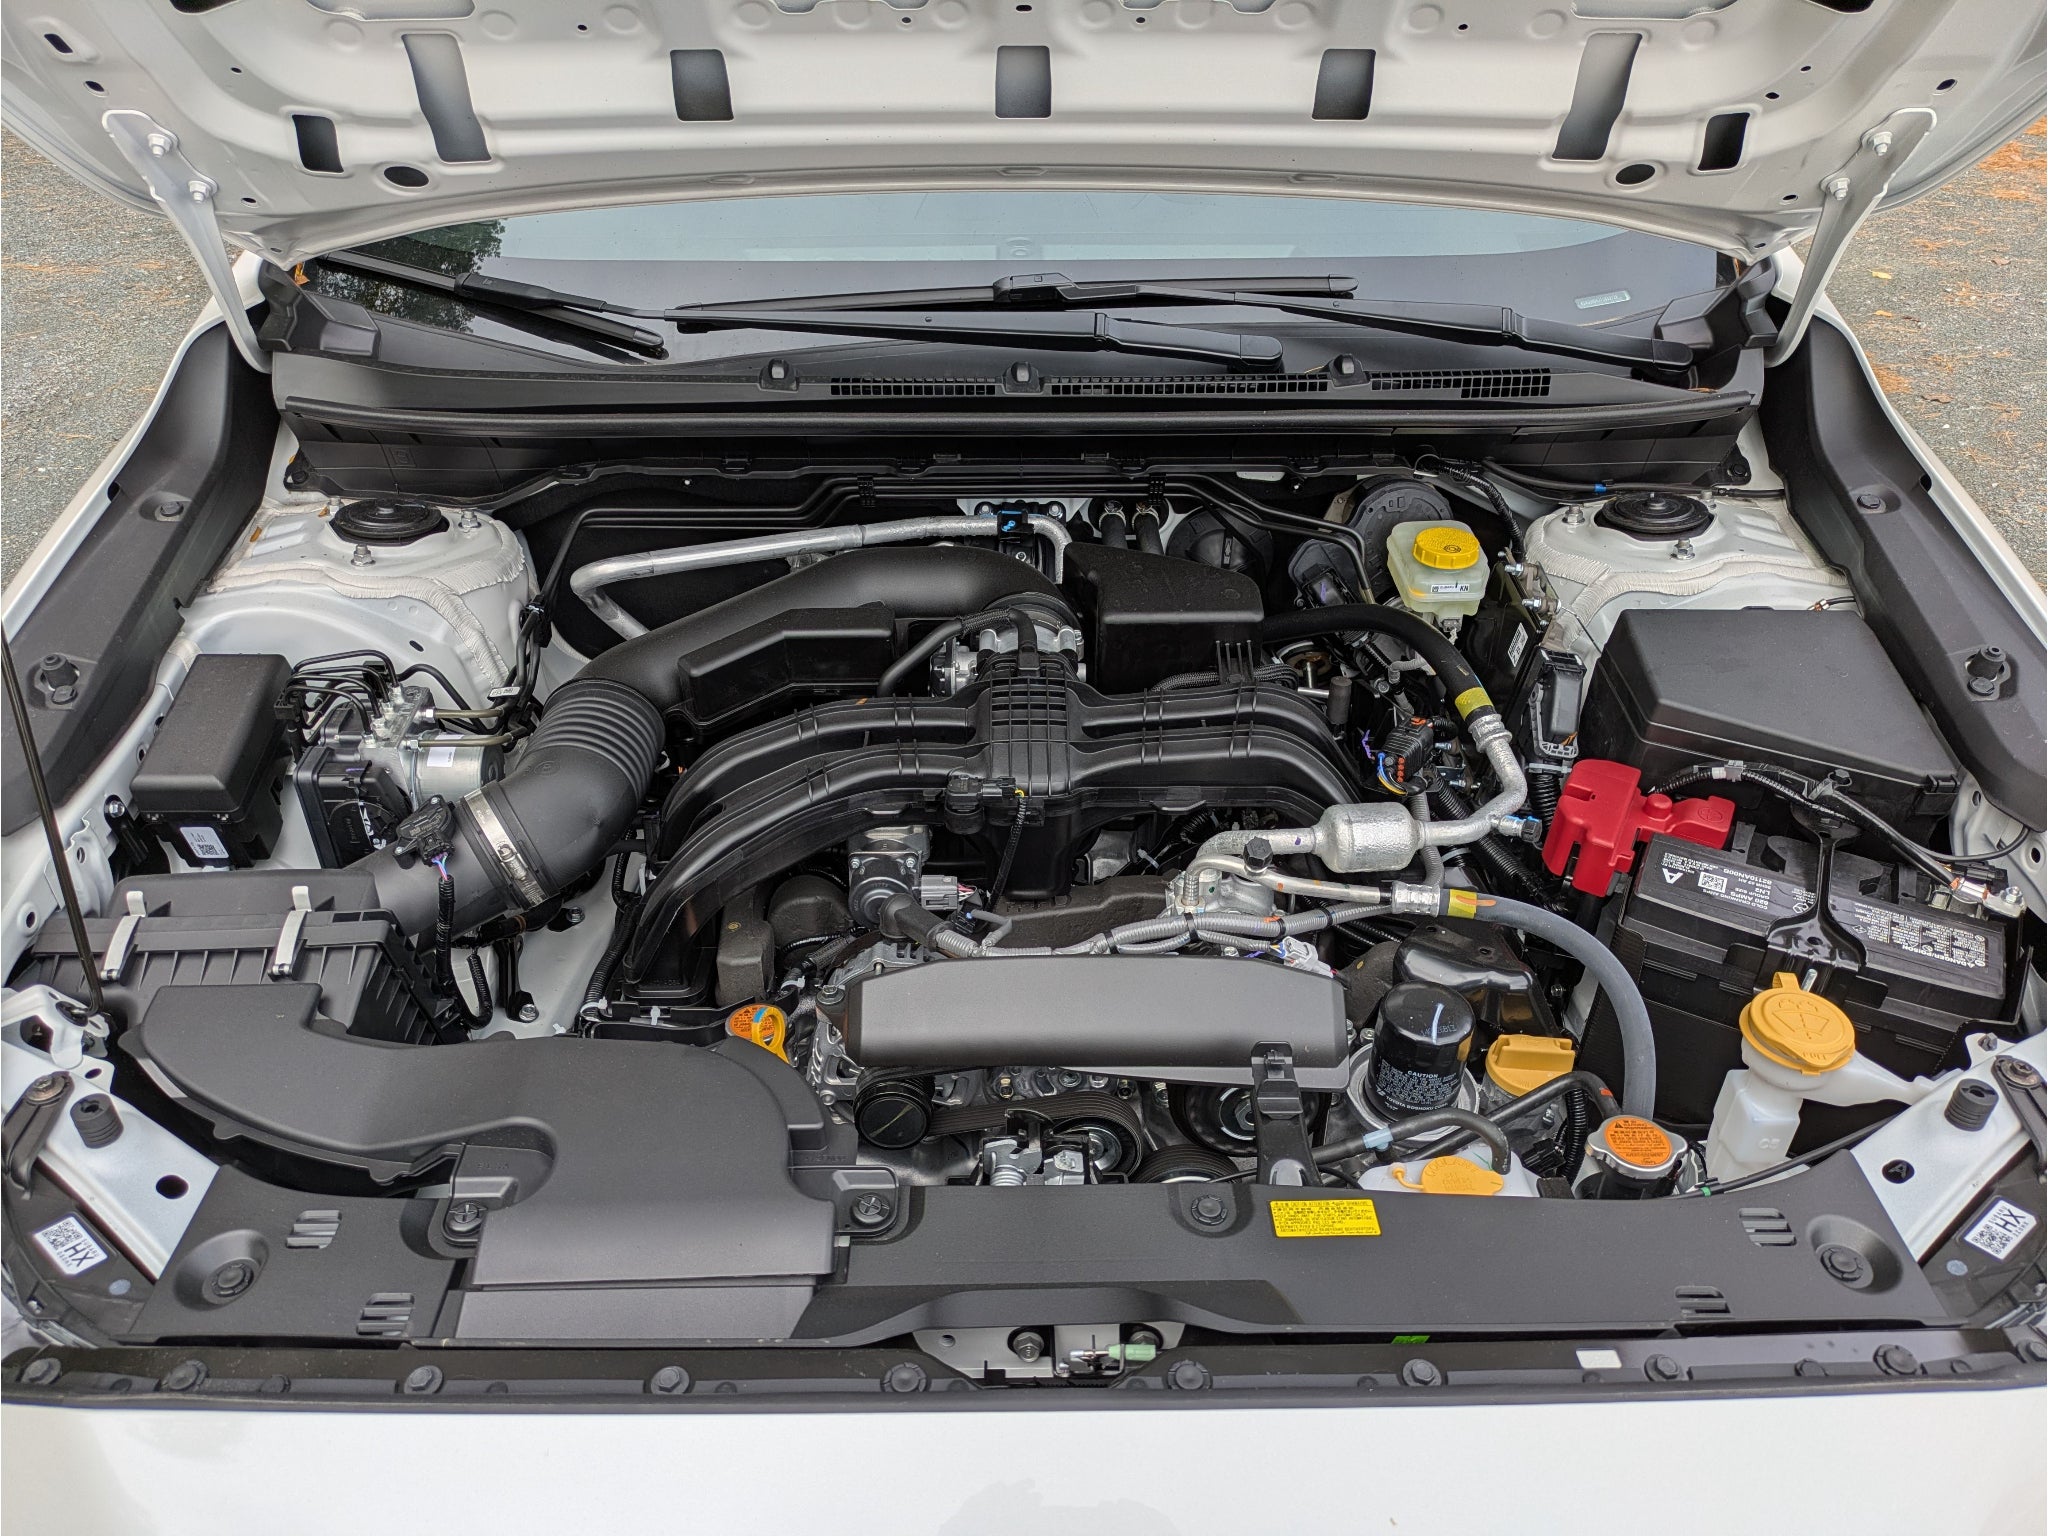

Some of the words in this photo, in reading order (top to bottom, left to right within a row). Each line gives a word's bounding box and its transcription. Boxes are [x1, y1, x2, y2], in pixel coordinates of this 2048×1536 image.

[1730, 891, 1754, 900] AMPS
[1407, 1070, 1439, 1079] CAUTION
[1994, 1208, 2026, 1233] HX
[64, 1242, 95, 1268] HX
